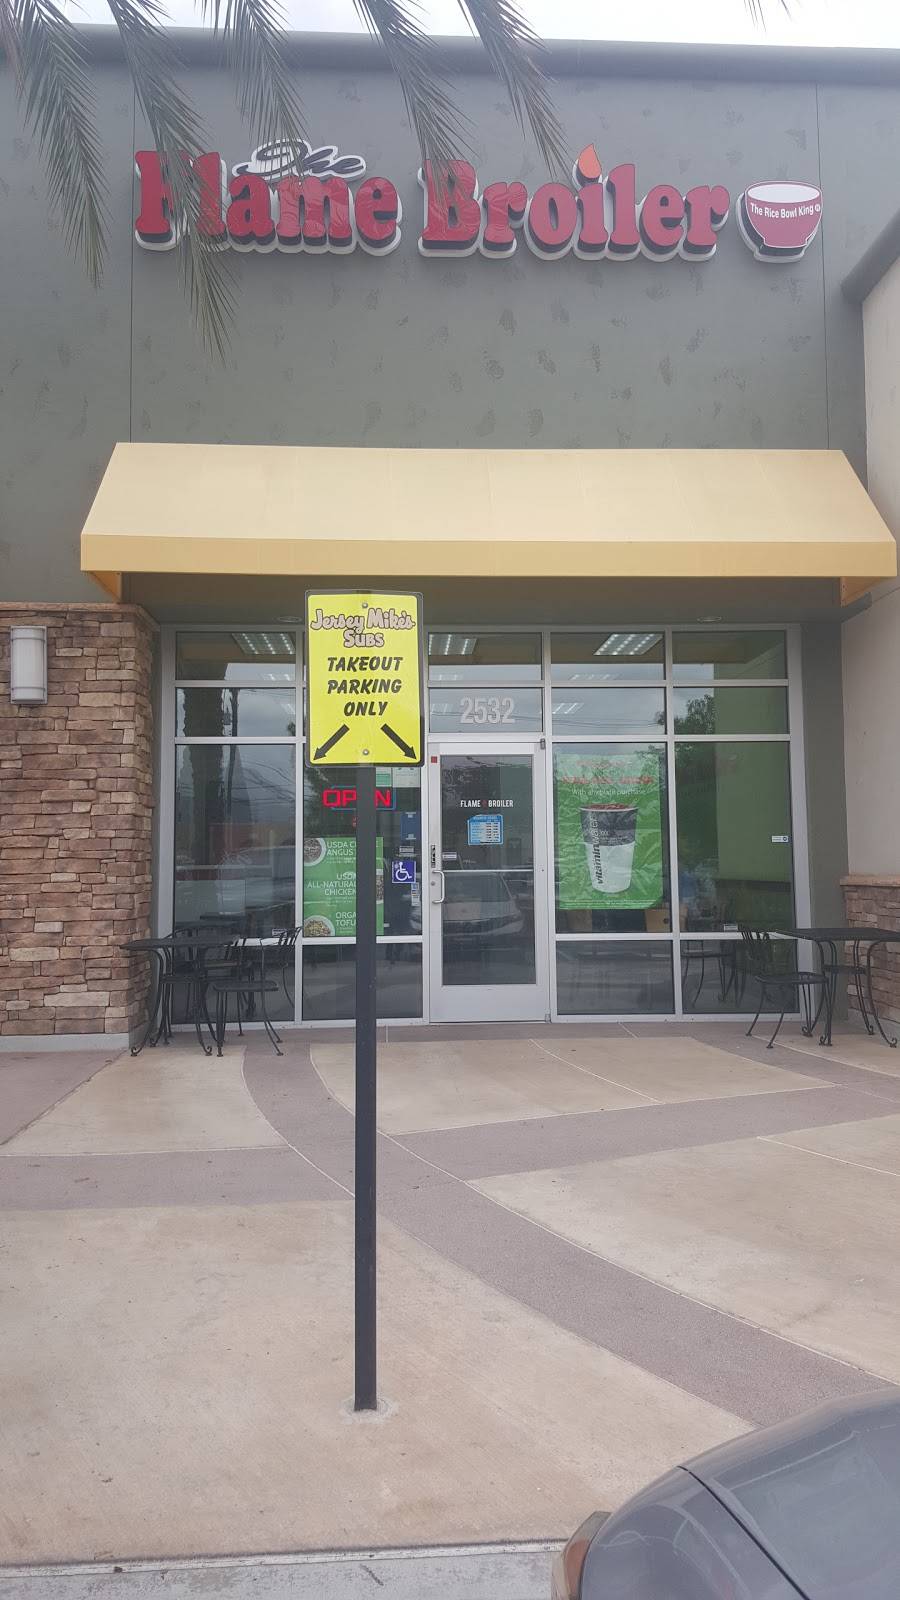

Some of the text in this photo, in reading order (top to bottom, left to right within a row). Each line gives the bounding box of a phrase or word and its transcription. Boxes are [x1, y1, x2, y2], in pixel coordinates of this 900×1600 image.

[232, 138, 366, 180] The
[135, 144, 731, 259] Flame Broiler
[750, 202, 814, 219] The Rice Bowl King
[310, 608, 416, 634] Jersey Mike's
[327, 656, 403, 672] TAKEOUT
[327, 679, 402, 695] PARKING
[343, 701, 388, 717] ONLY
[460, 697, 516, 724] 2532
[322, 789, 391, 807] OPN
[460, 799, 514, 808] FLAME BROILER
[326, 841, 348, 849] USDA
